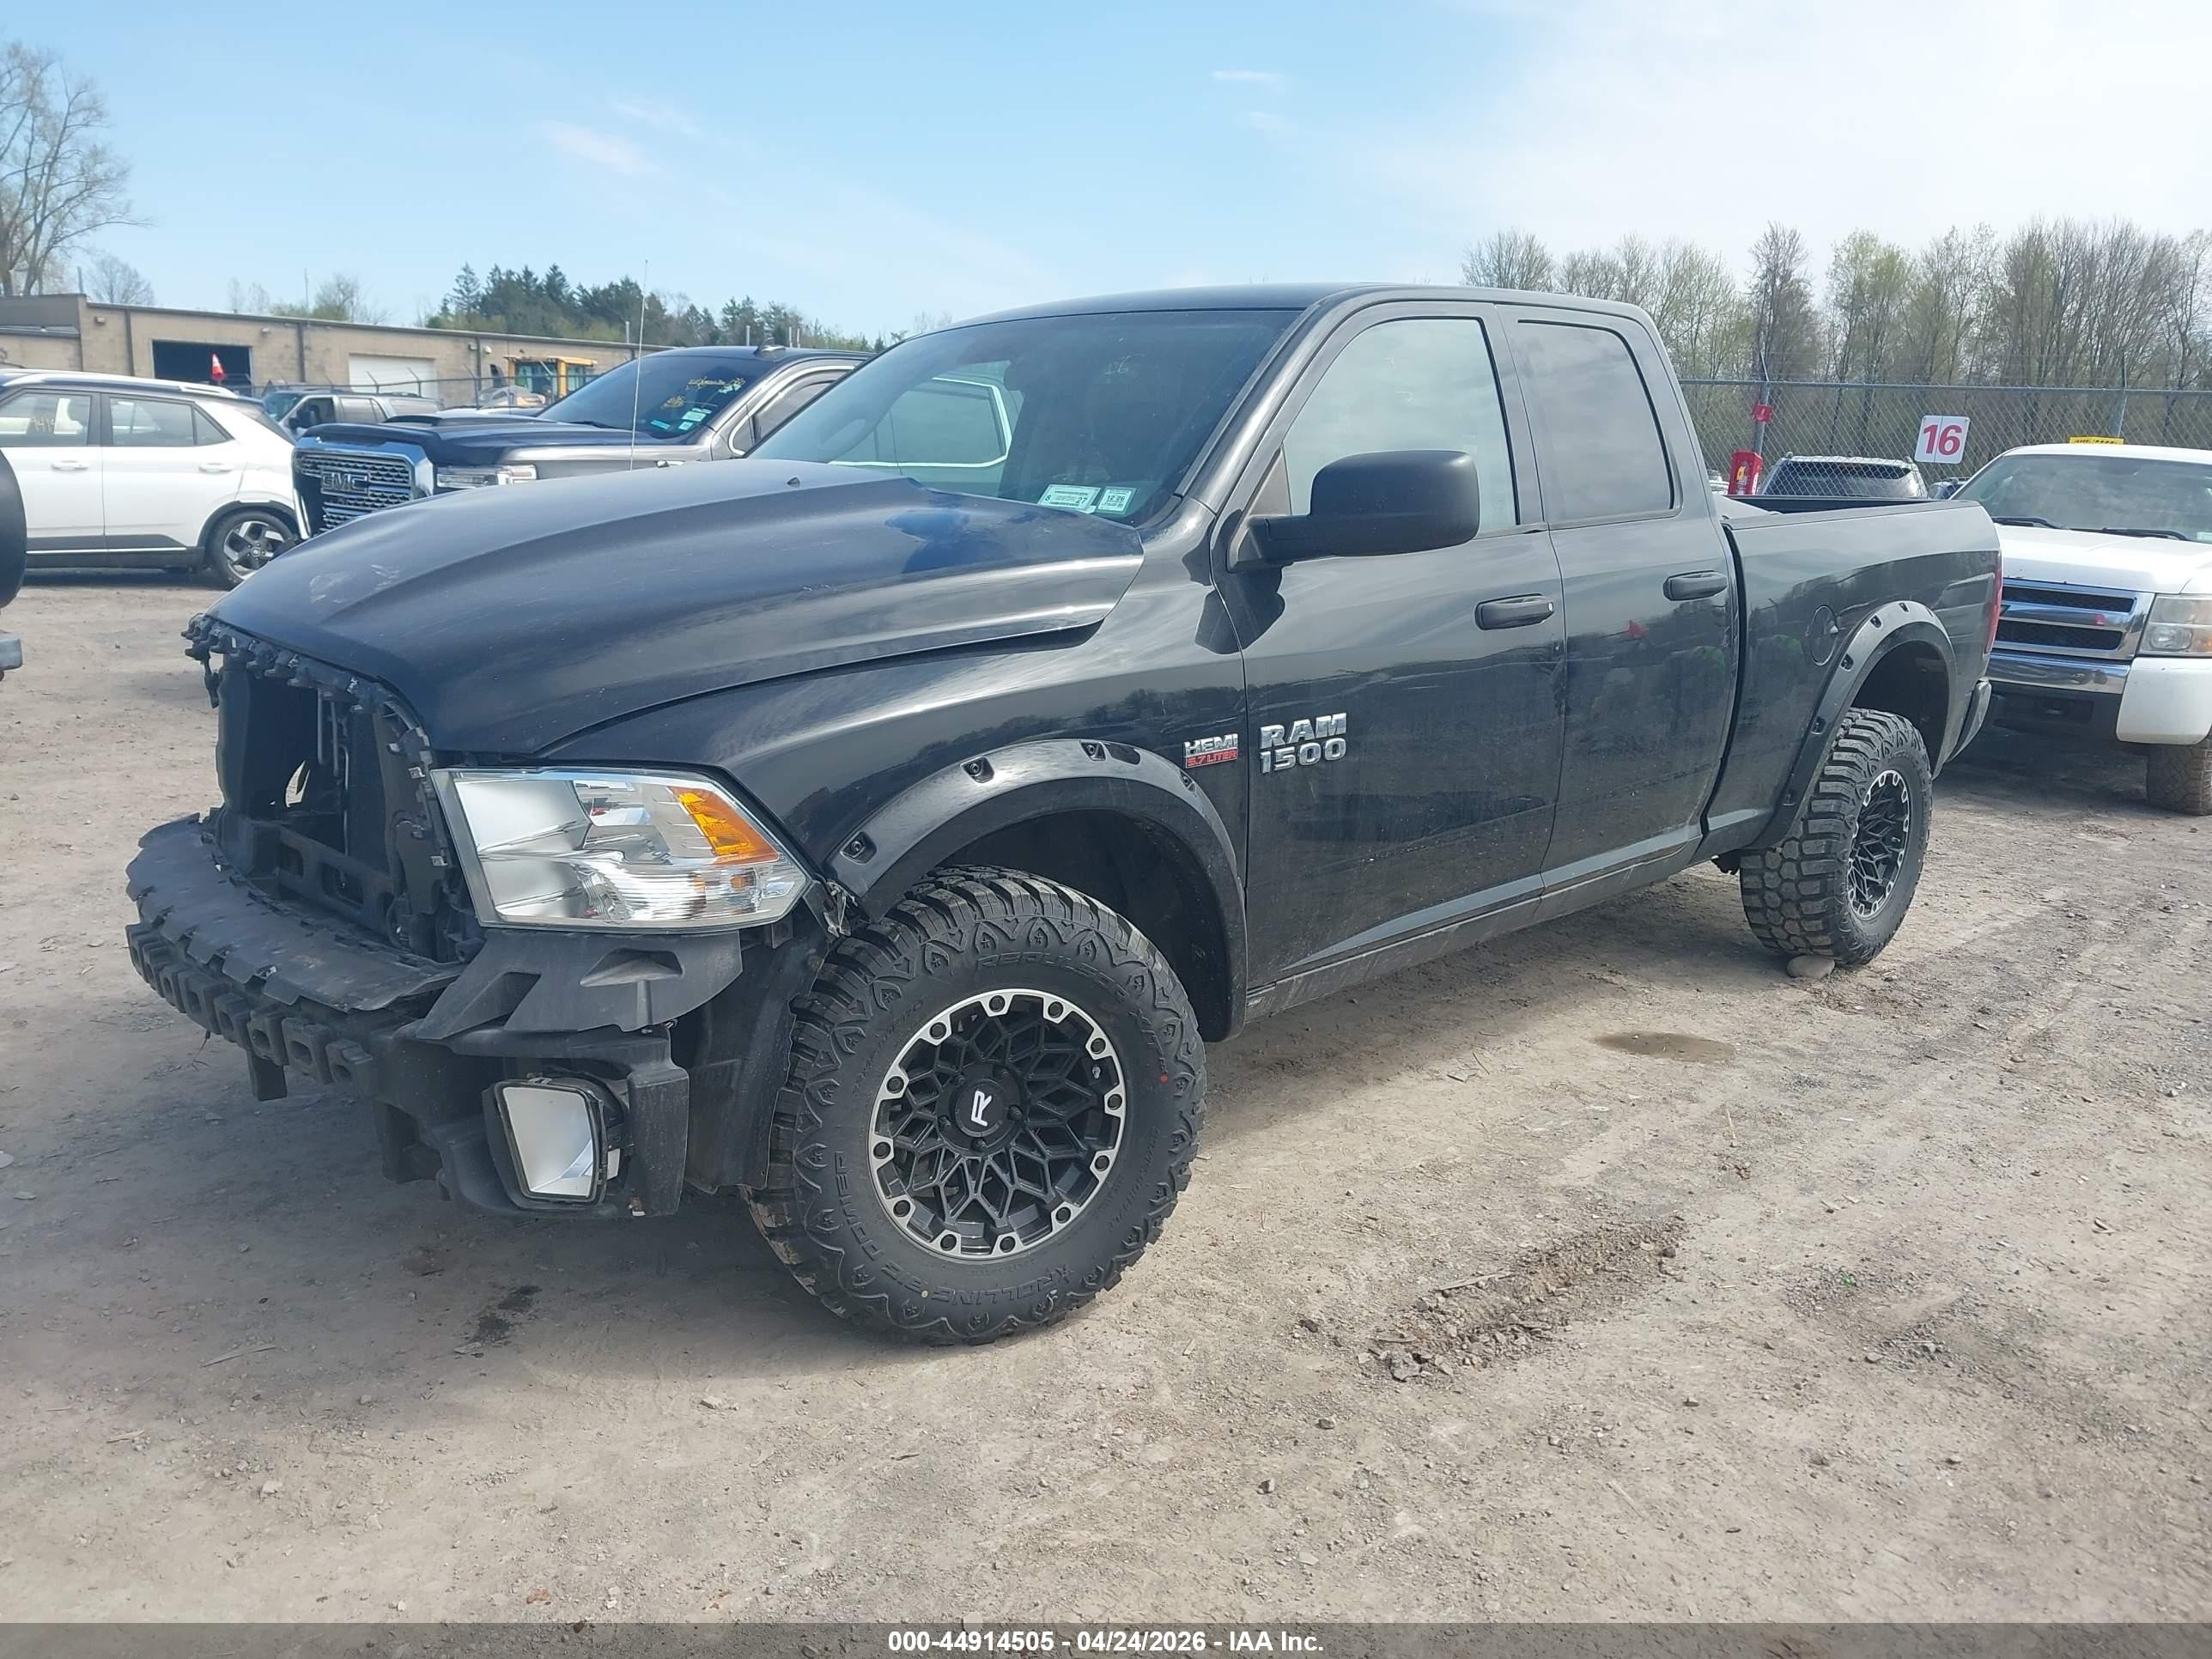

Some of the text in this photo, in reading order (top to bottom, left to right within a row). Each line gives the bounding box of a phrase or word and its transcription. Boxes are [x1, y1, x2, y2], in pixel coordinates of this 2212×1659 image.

[1923, 424, 1962, 456] 16
[322, 473, 367, 492] GMC
[1183, 733, 1238, 757] HEMI
[1260, 712, 1346, 750] RAM
[1206, 749, 1237, 763] LITER
[1260, 738, 1346, 774] 1500
